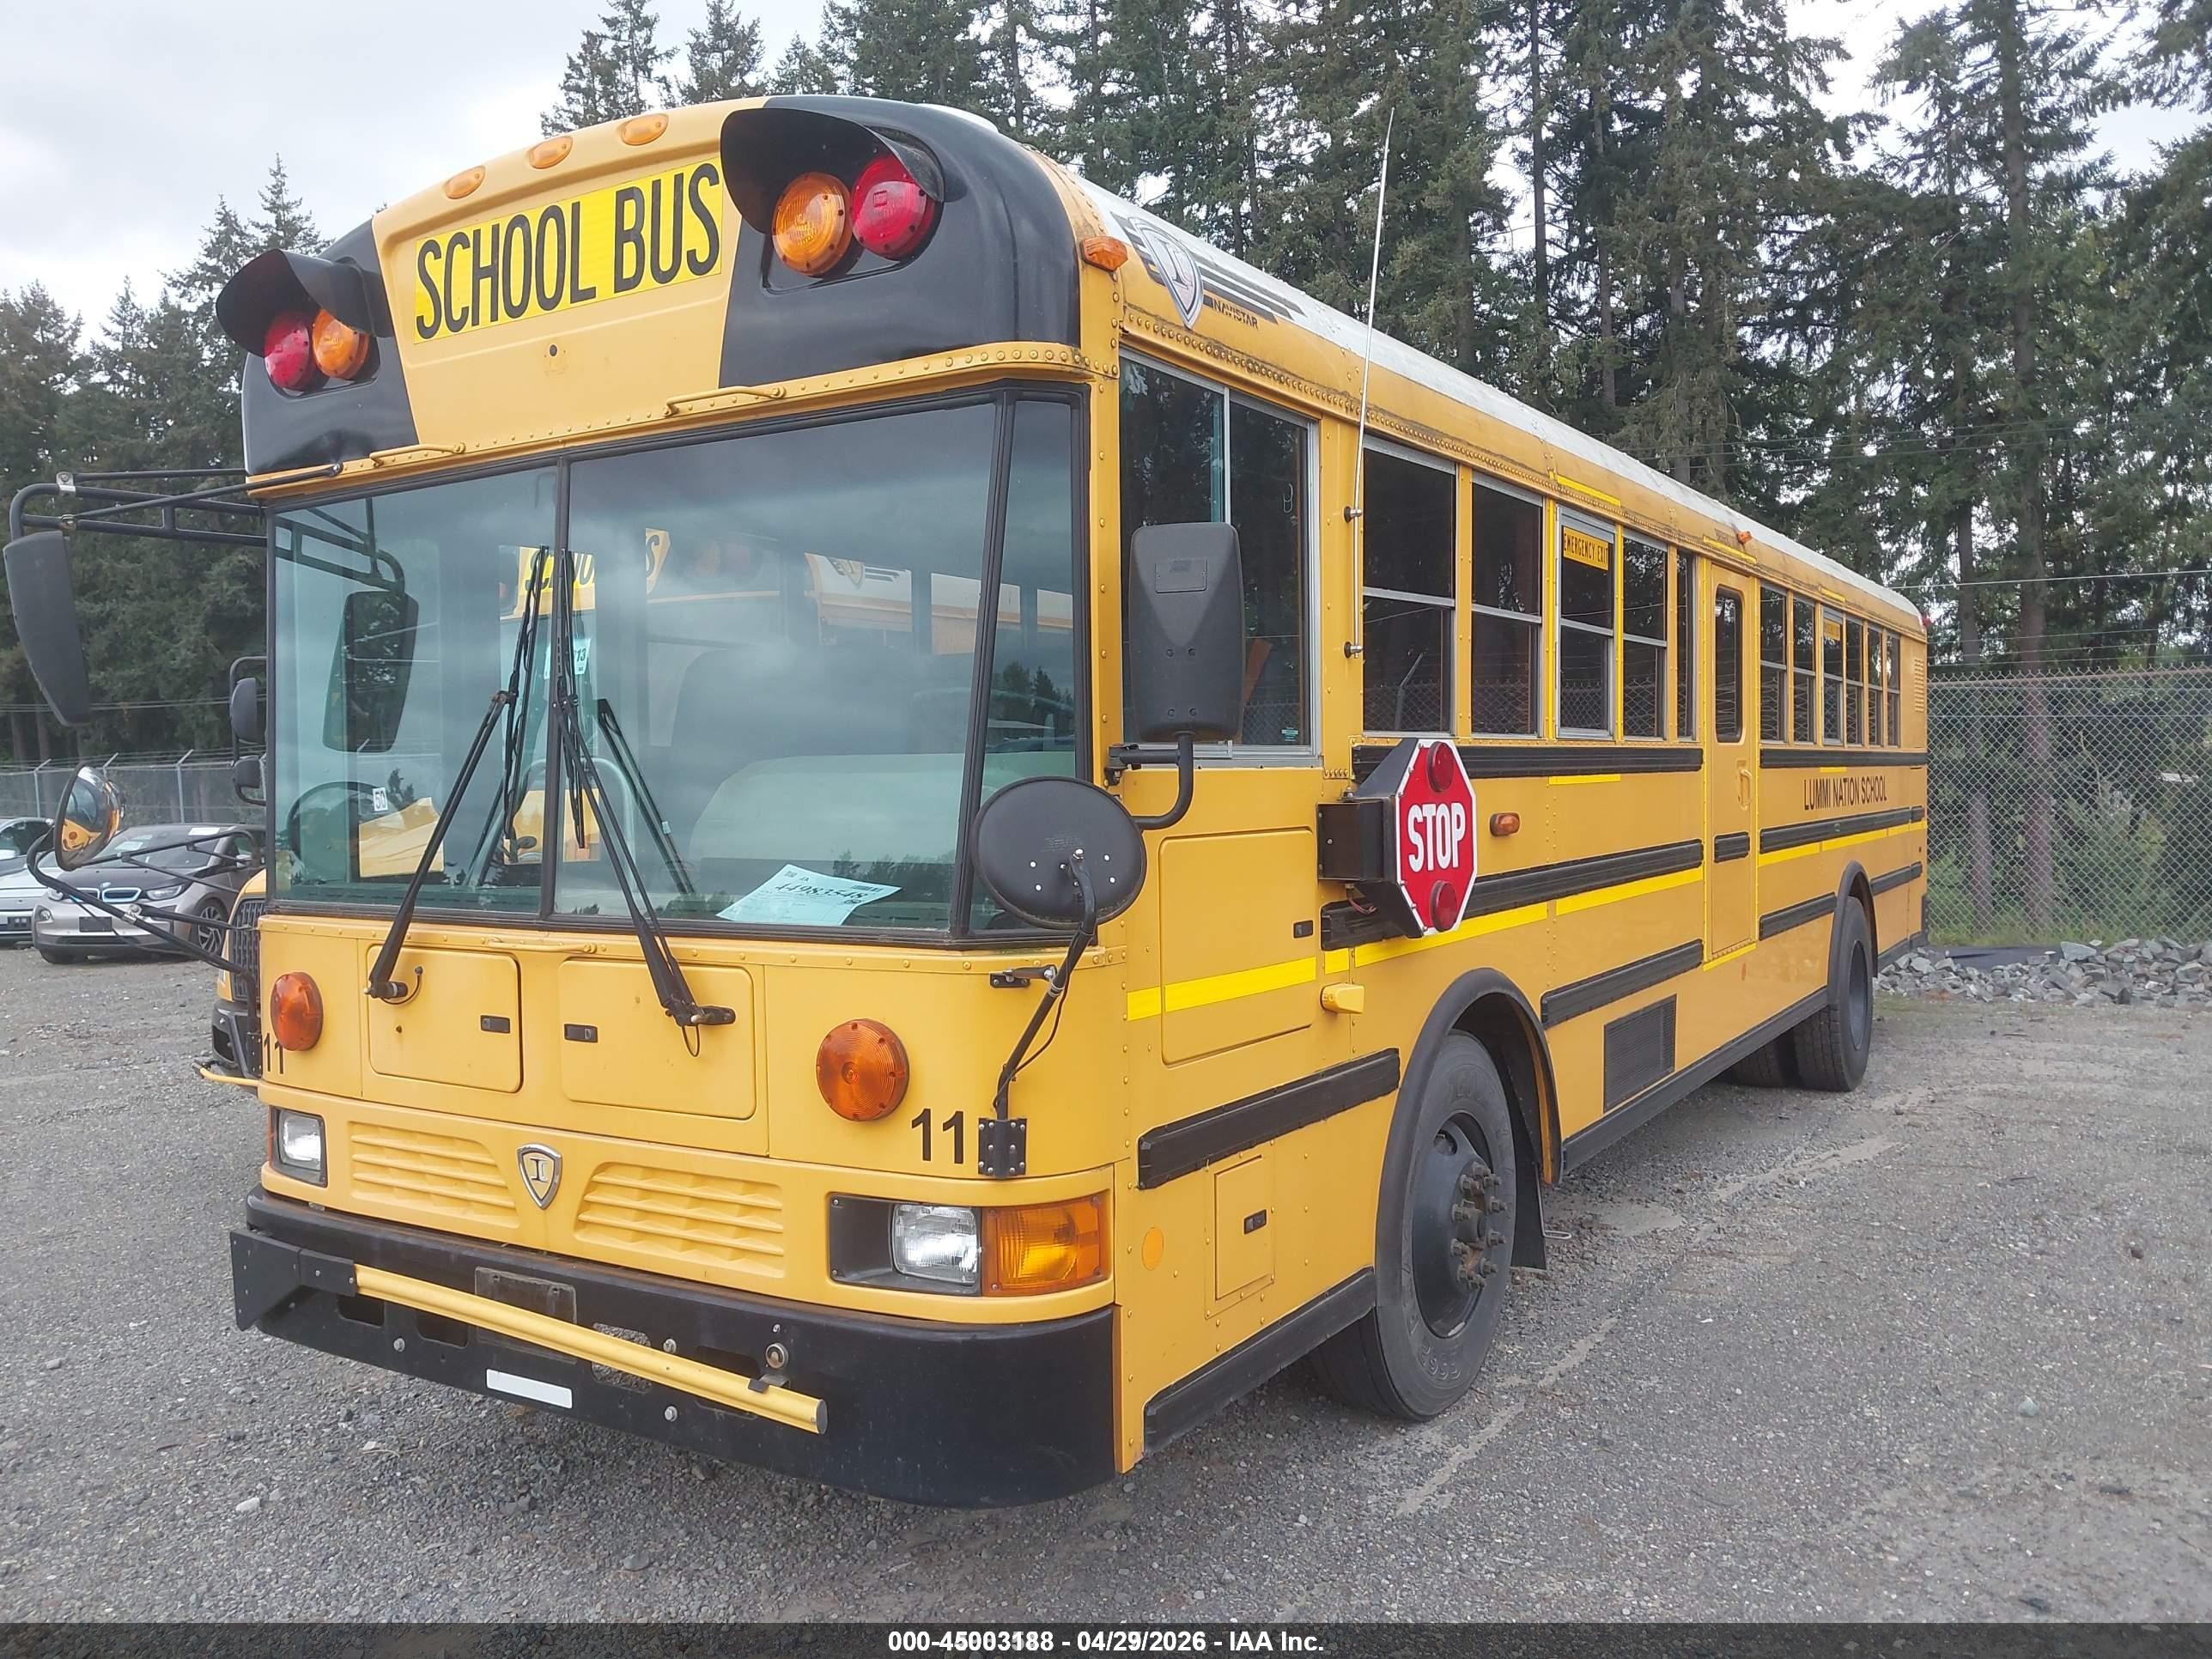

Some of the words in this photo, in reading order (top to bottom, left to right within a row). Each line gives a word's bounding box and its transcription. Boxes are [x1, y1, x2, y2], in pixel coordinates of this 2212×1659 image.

[416, 200, 598, 340] SCHOOL
[613, 161, 720, 292] BUS
[1213, 298, 1259, 330] NAVISTAR
[1564, 532, 1595, 559] EMERGENCY
[1597, 544, 1608, 561] EXIT
[1803, 778, 1832, 811] LUMMI
[1833, 776, 1860, 808] NATION
[1861, 775, 1887, 805] SCHOOL
[1407, 802, 1466, 872] STOP
[264, 1032, 284, 1075] 11
[911, 1108, 964, 1164] 11
